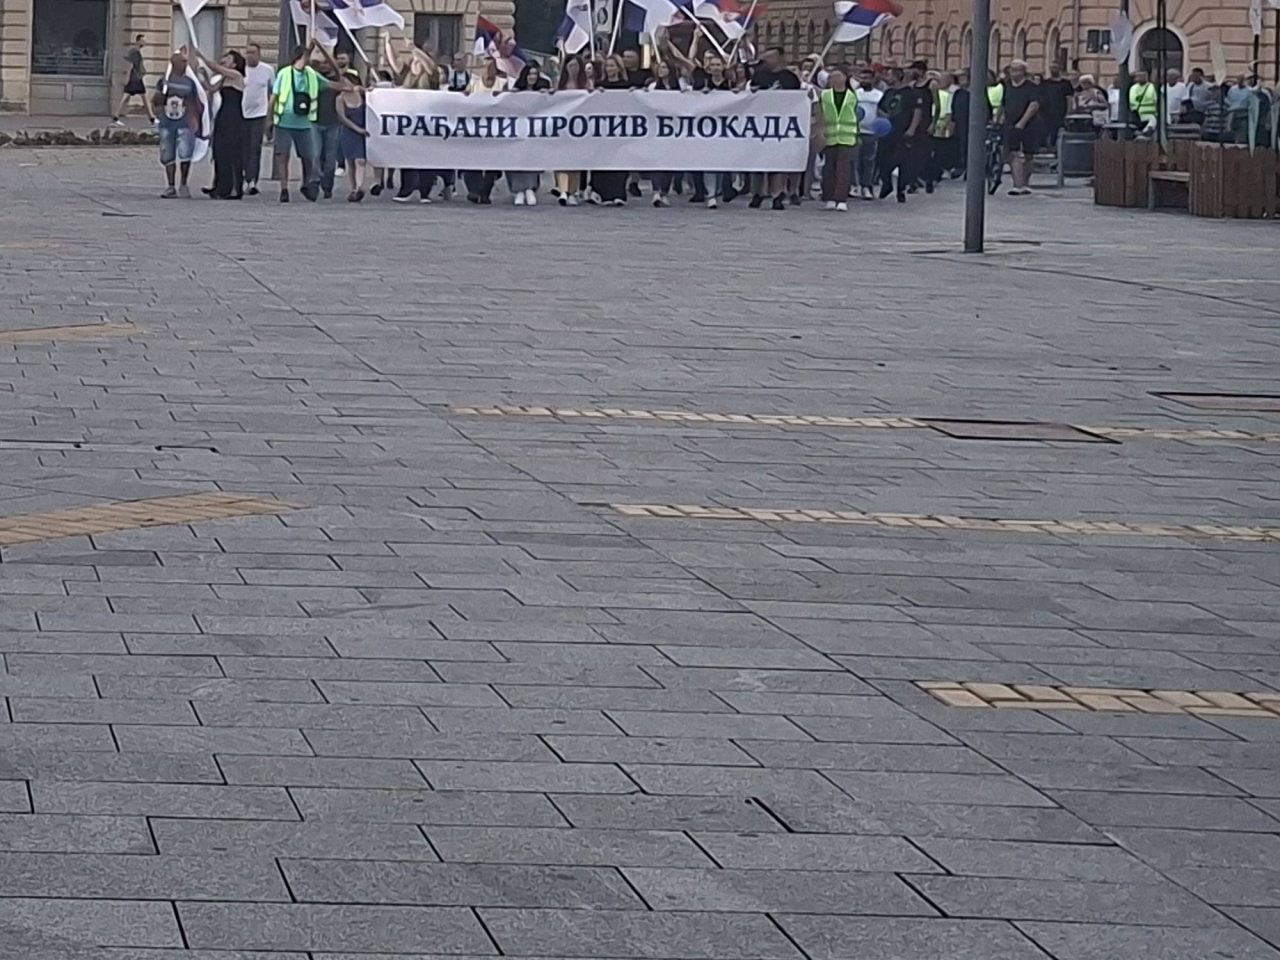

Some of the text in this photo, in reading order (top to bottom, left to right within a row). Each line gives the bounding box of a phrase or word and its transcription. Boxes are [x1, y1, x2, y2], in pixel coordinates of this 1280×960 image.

[380, 114, 805, 142] ГРАЂАНИ ПРОТИВ БЛОКАДА
